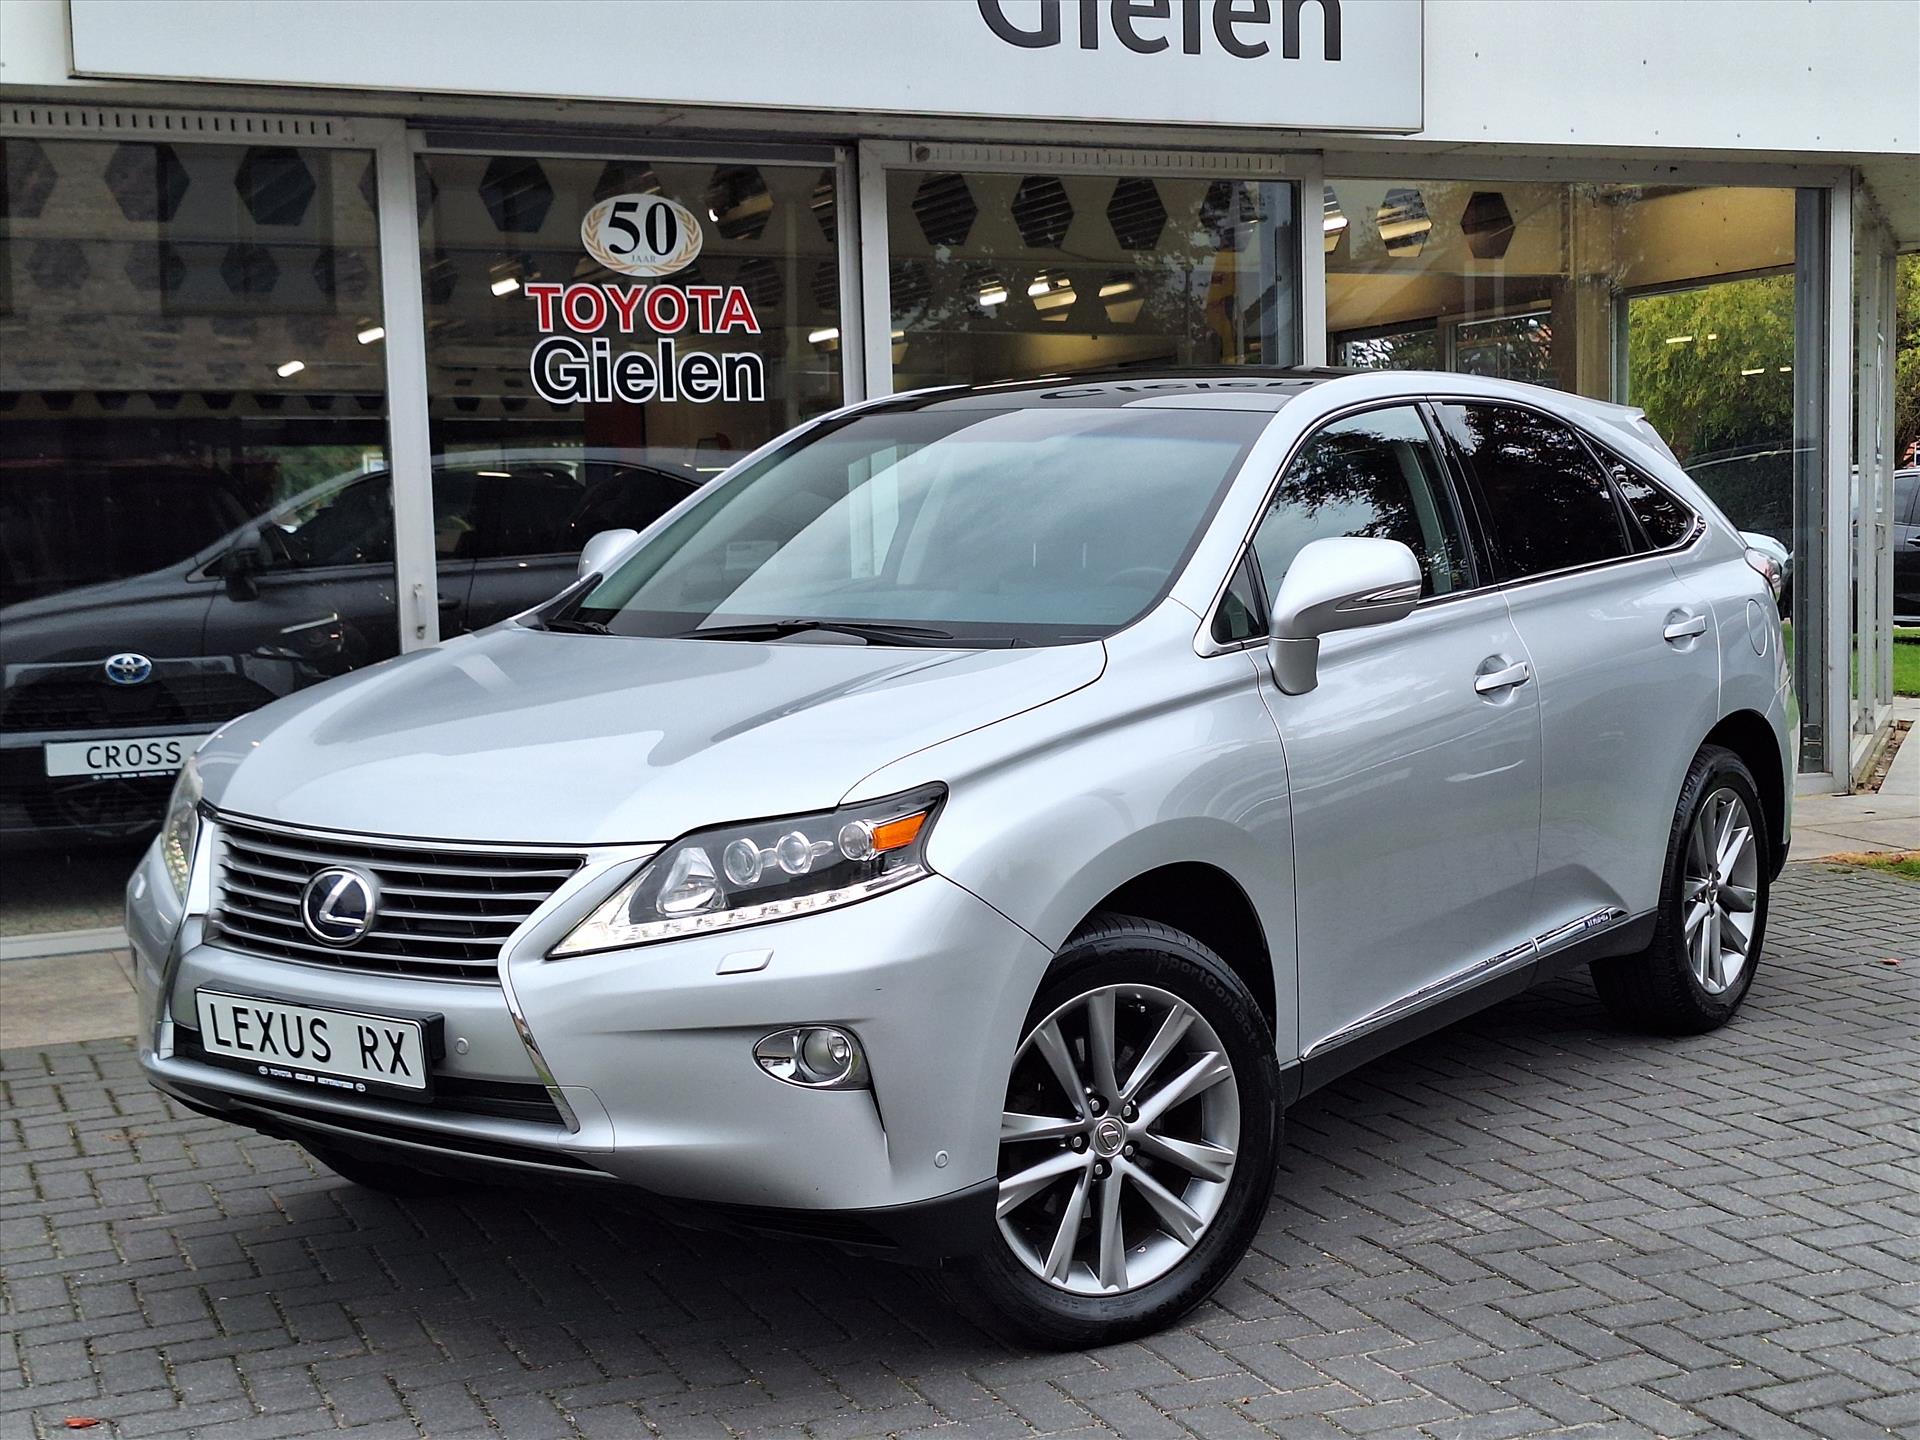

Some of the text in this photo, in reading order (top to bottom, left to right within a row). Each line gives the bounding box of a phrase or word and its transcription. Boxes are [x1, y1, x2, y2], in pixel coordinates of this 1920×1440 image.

[608, 201, 678, 256] 50
[630, 254, 657, 264] JAAR
[525, 283, 761, 333] TOYOTA
[530, 336, 765, 403] Gielen
[86, 741, 182, 769] CROSS
[210, 1002, 412, 1077] LEXUS RX
